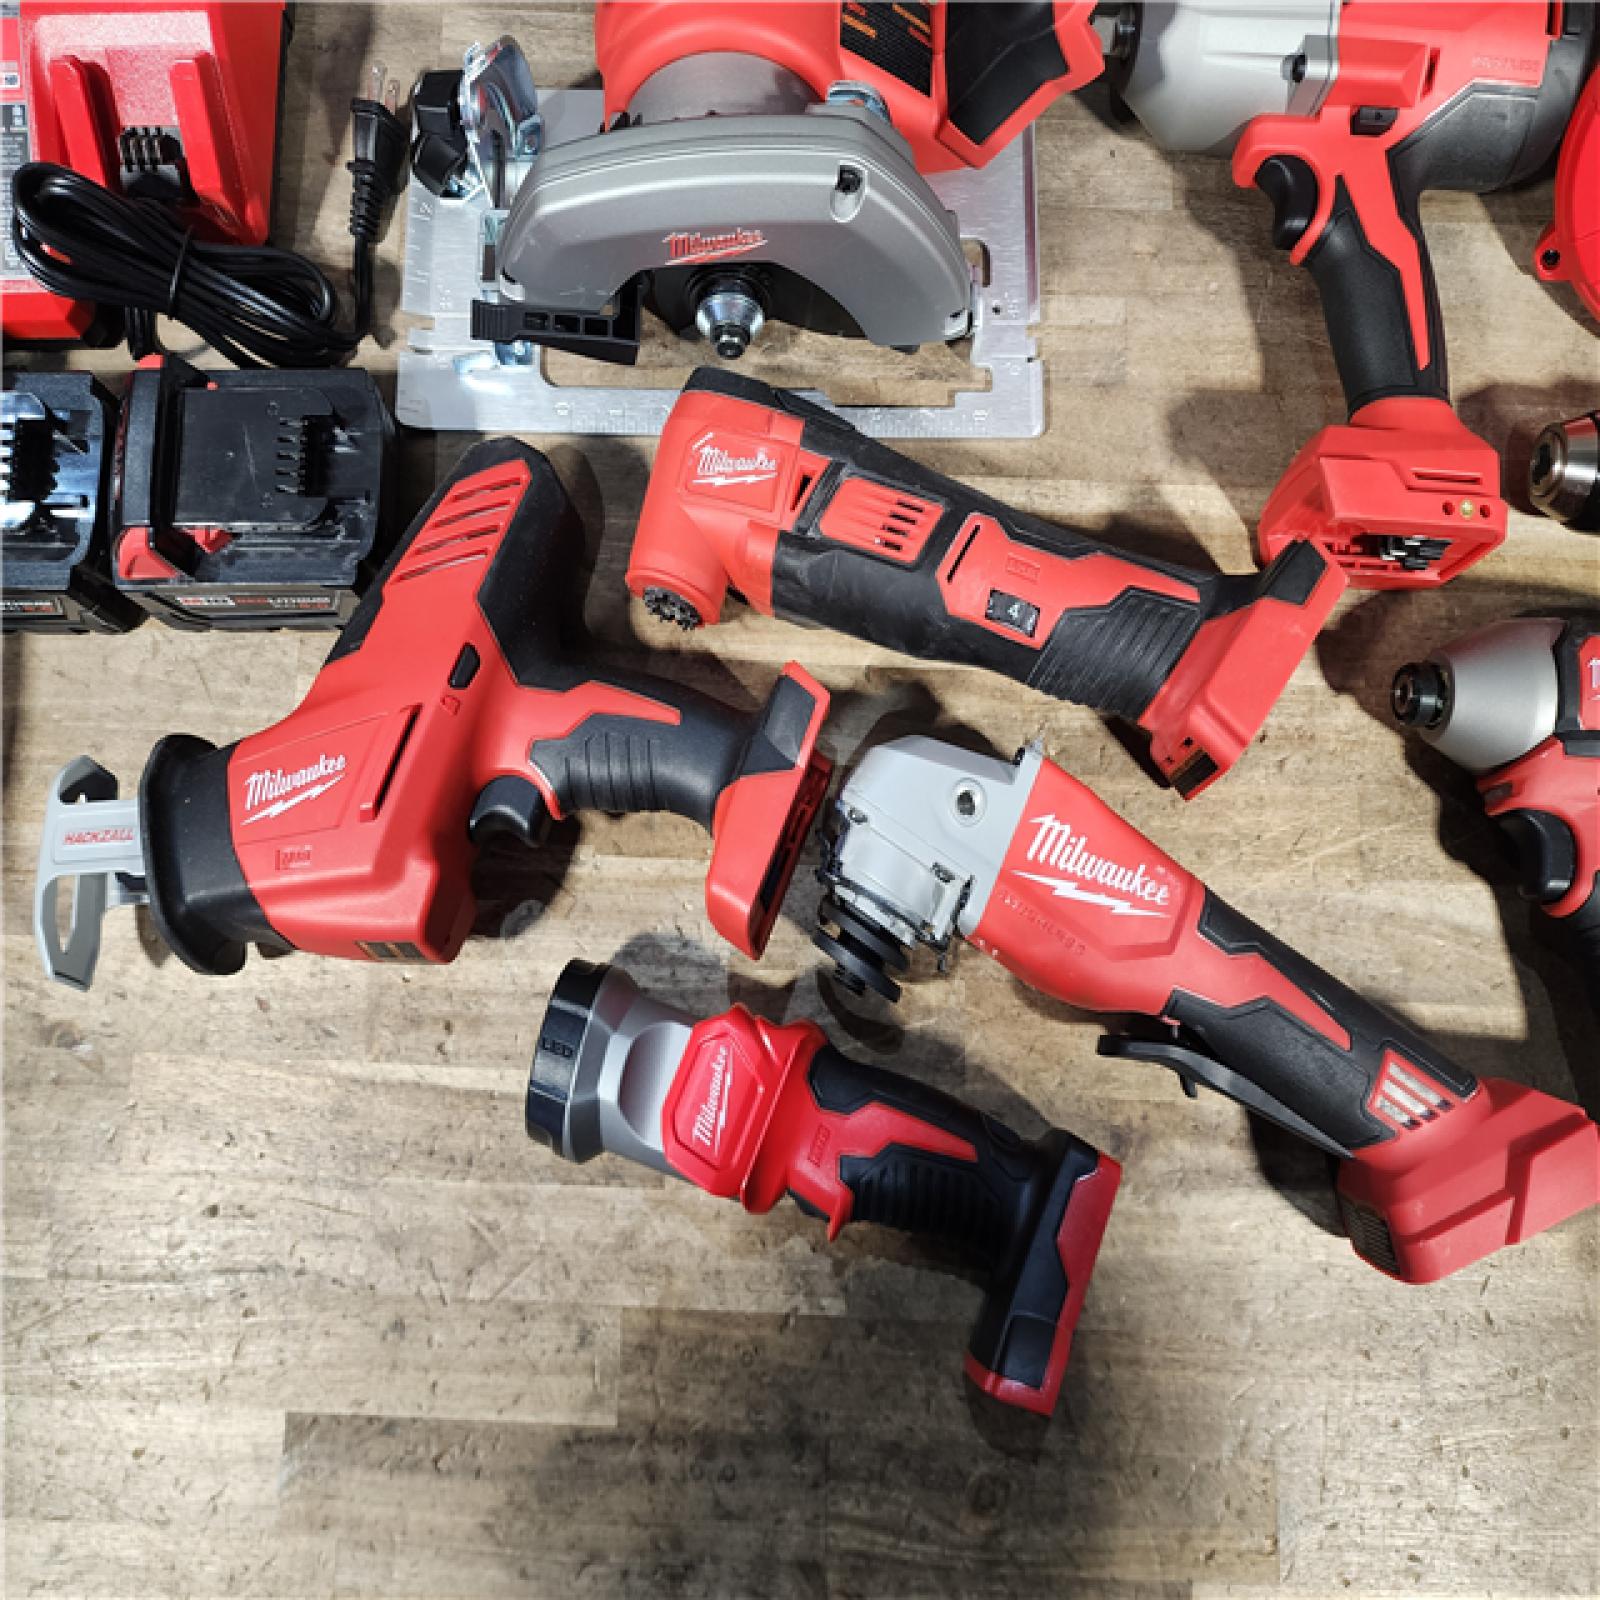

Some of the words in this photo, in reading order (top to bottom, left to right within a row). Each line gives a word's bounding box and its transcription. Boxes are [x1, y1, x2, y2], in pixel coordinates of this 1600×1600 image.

[662, 227, 763, 258] Milwaukee
[694, 442, 777, 476] Milwaukee
[1006, 602, 1022, 620] 4
[244, 752, 346, 811] Milwaukee
[64, 828, 134, 846] HACKZALL
[1027, 814, 1169, 906] Milwaukee
[542, 1037, 573, 1058] LED
[692, 1045, 727, 1147] Milwaukee
